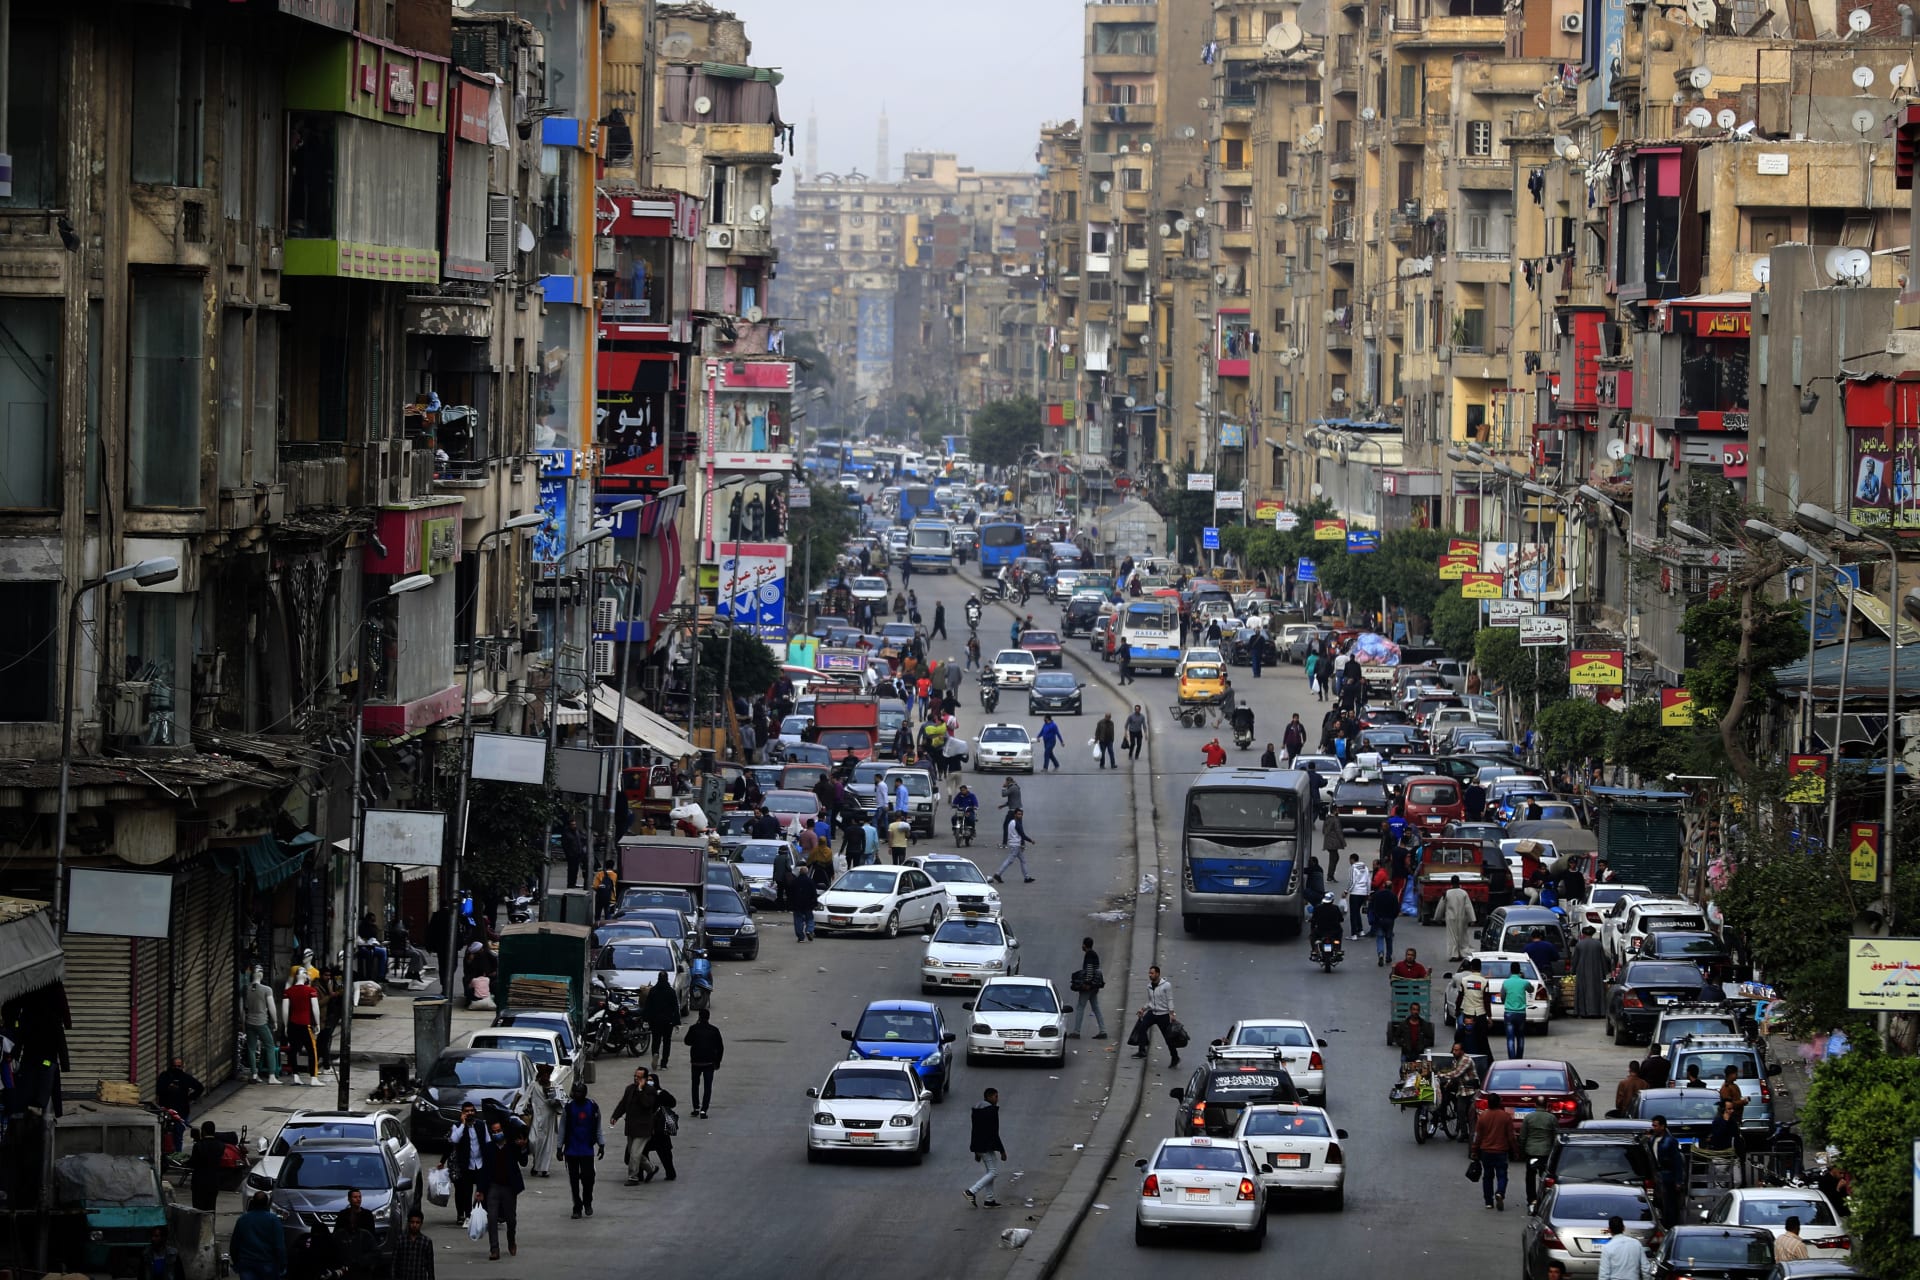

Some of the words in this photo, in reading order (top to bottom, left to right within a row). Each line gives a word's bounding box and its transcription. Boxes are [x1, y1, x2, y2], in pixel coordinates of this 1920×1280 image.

[1707, 314, 1739, 335] الشام
[614, 397, 651, 437] أبو
[1544, 623, 1565, 632] أشرف
[1871, 961, 1903, 971] الشروق
